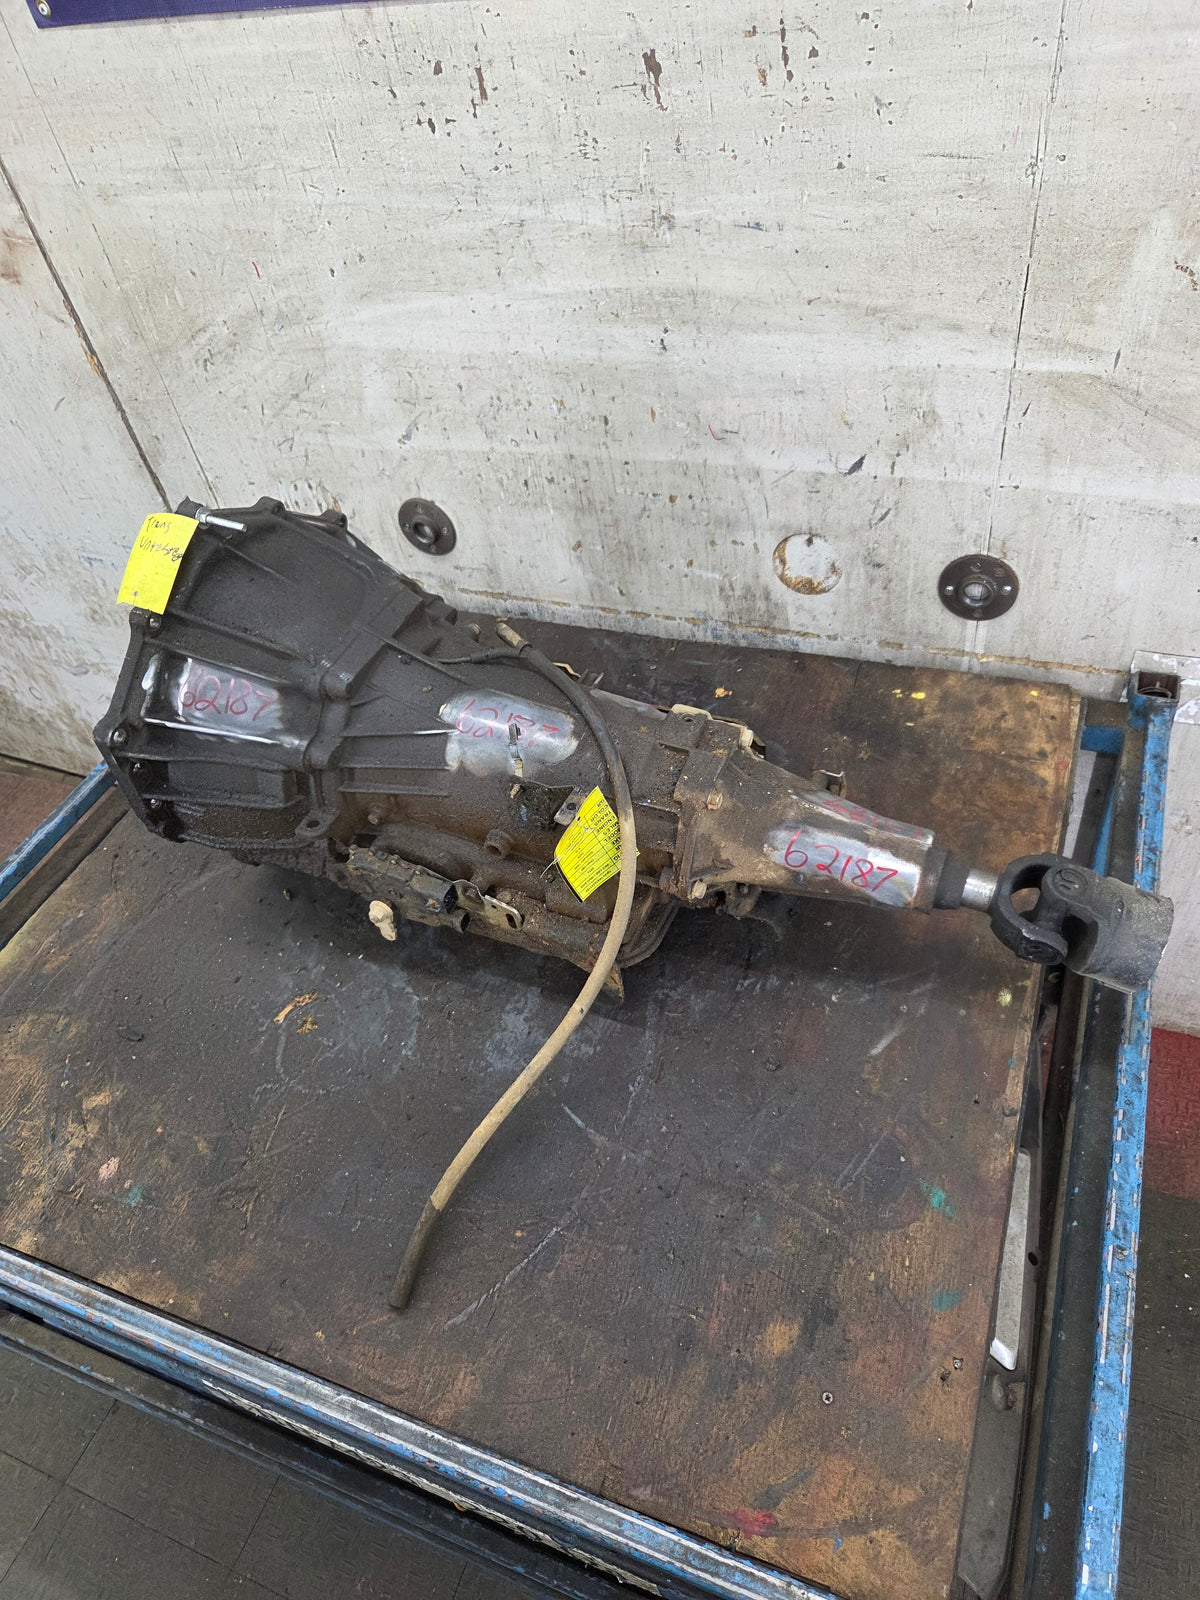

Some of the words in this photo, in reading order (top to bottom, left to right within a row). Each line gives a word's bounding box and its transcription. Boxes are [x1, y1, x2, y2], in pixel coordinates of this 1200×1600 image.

[178, 669, 274, 721] 62187
[593, 810, 611, 826] TRANS
[596, 815, 616, 833] ENGINE
[784, 829, 899, 892] 62187
